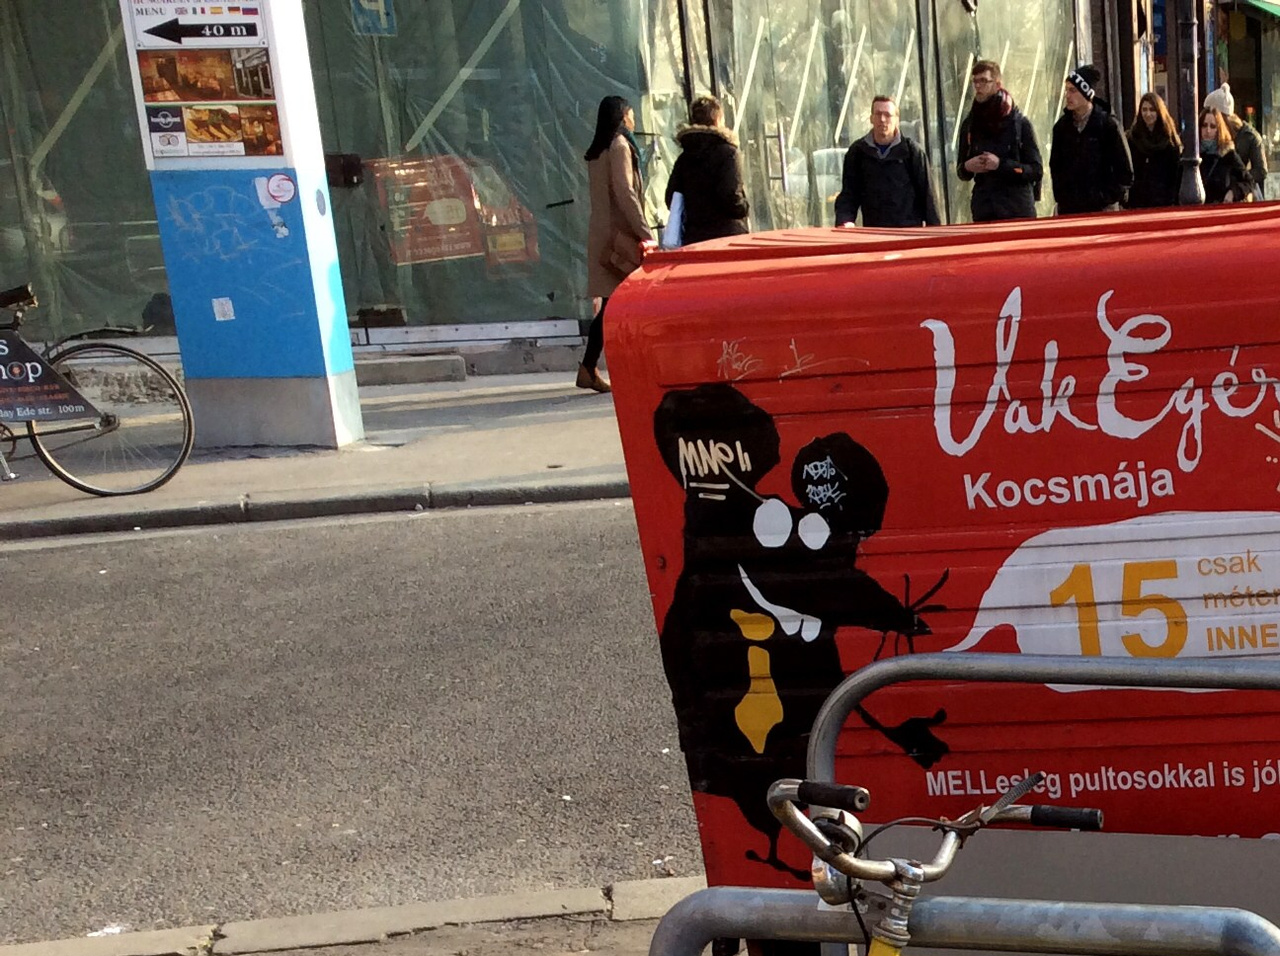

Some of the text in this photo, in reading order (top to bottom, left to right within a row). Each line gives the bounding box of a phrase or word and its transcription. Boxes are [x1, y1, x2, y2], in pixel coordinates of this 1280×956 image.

[135, 7, 167, 19] MENU
[201, 25, 247, 36] 40 m
[920, 286, 1098, 457] Vak
[16, 406, 36, 417] Ede
[963, 460, 1176, 510] Kocsmája
[1049, 550, 1263, 659] 15 csak
[1069, 761, 1215, 799] pultosokkal
[1223, 761, 1245, 787] is
